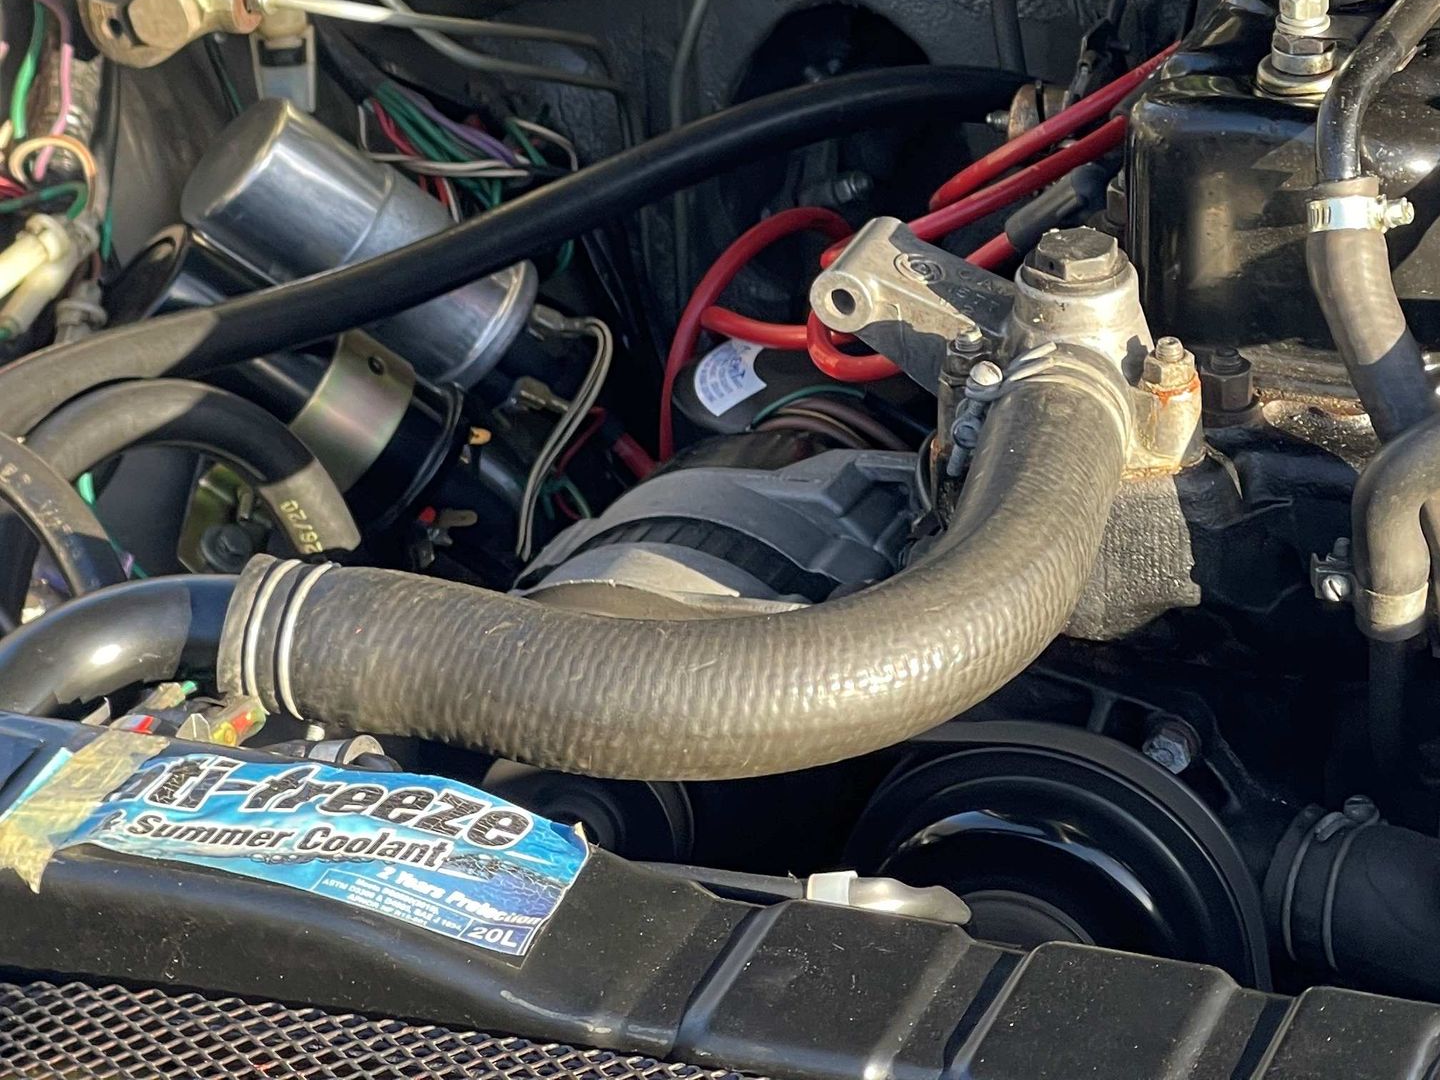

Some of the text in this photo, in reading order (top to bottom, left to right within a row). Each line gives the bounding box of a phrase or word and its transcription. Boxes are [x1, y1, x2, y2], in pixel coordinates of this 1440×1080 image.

[102, 754, 534, 848] nti-freeze
[127, 814, 296, 850] Summer
[298, 825, 447, 867] Coolant
[376, 866, 545, 926] 2 Years Protection
[467, 926, 517, 949] 20L
